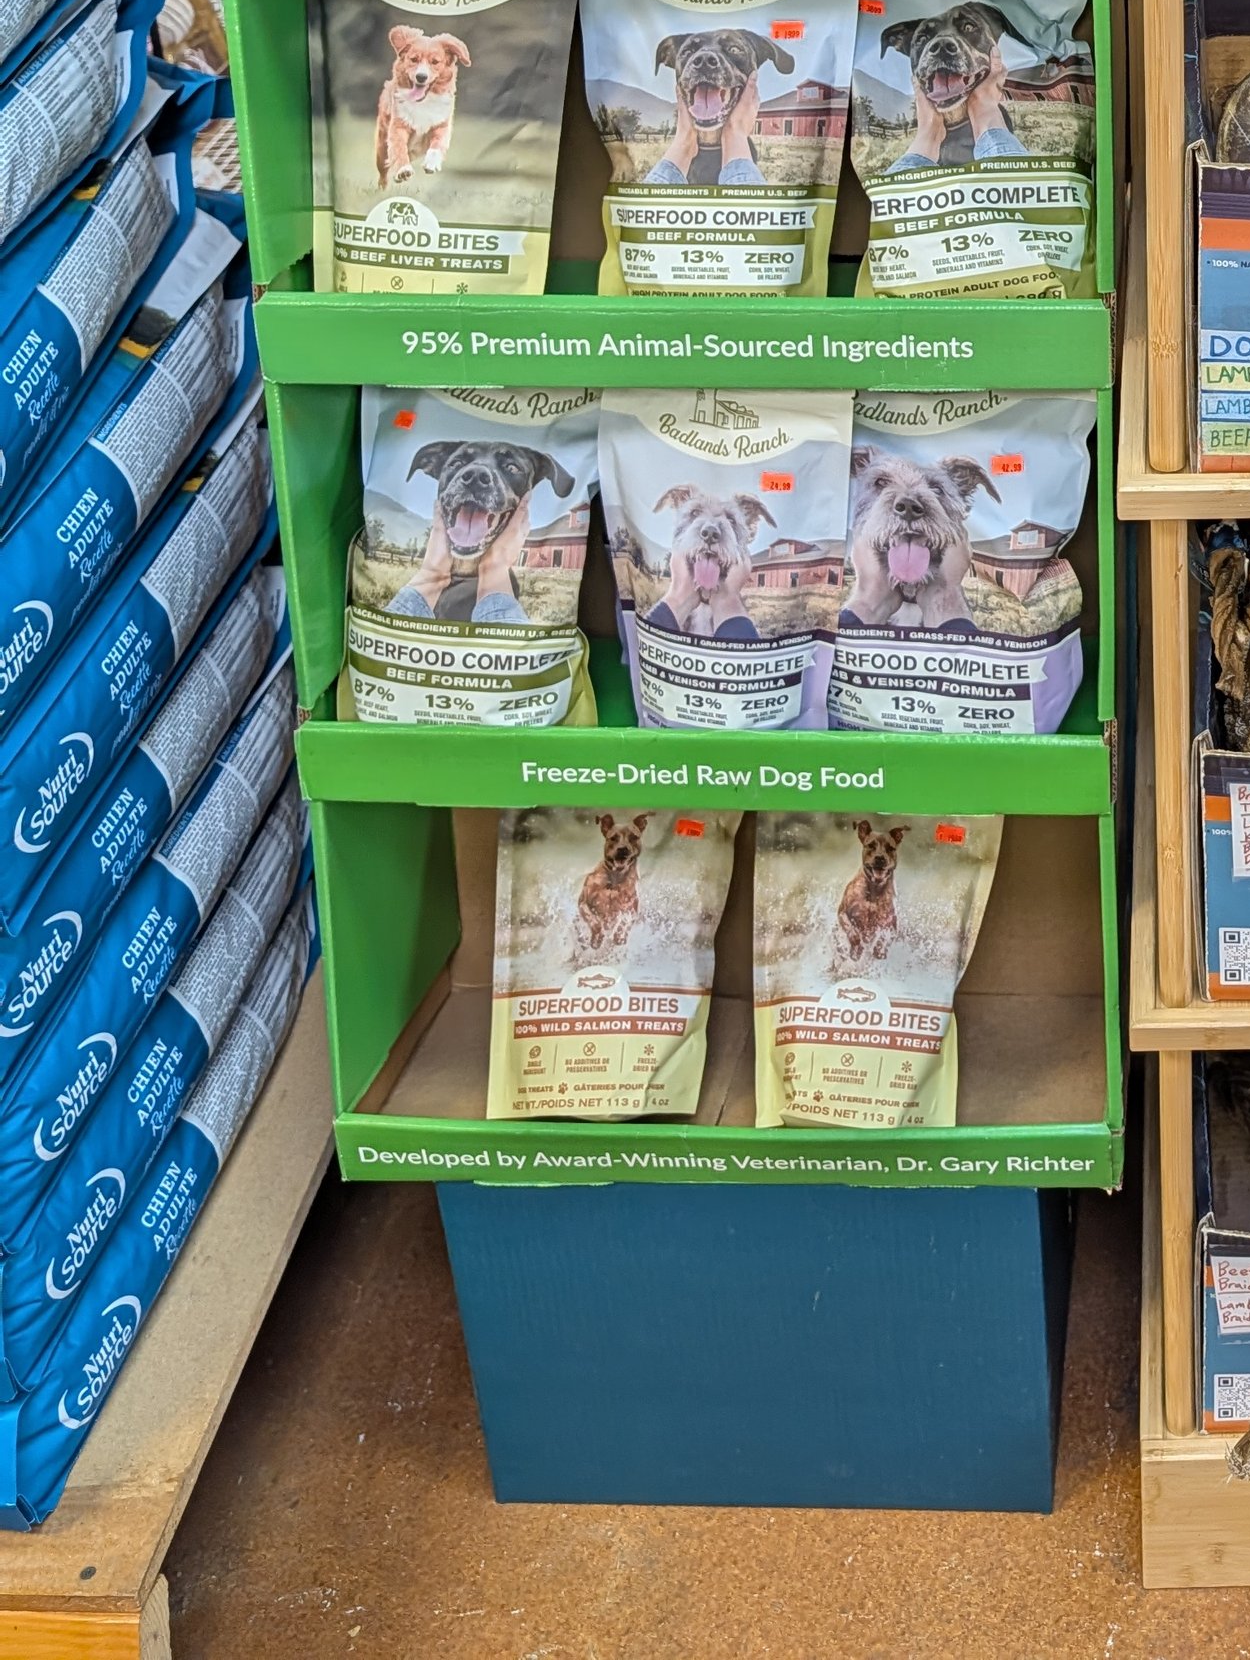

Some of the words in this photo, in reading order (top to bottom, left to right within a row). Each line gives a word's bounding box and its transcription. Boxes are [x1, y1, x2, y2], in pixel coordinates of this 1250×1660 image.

[401, 331, 463, 355] 95%
[471, 331, 591, 356] Premium
[598, 333, 814, 358] Animal-Sourced
[822, 335, 975, 363] Ingredients
[101, 619, 140, 676] CHIEN
[109, 631, 152, 701] ADULTE
[30, 762, 85, 841] Source
[38, 747, 78, 807] Nutri
[522, 761, 688, 786] Freeze-Dried
[697, 764, 752, 786] Raw
[760, 766, 813, 792] Dog
[819, 767, 885, 789] Food
[519, 996, 623, 1017] SUPERFOOD
[628, 996, 679, 1014] BITES
[140, 1160, 182, 1229] CHIEN
[358, 1146, 490, 1171] Developed
[497, 1148, 527, 1172] by
[534, 1148, 726, 1173] Award-Winning
[731, 1151, 890, 1175] Veterinarian,
[897, 1154, 933, 1174] Dr.
[941, 1154, 1001, 1180] Gary
[1006, 1154, 1096, 1175] Richter
[152, 1166, 199, 1252] ADULTE
[76, 1325, 134, 1417] Source
[82, 1315, 125, 1383] Nutri
